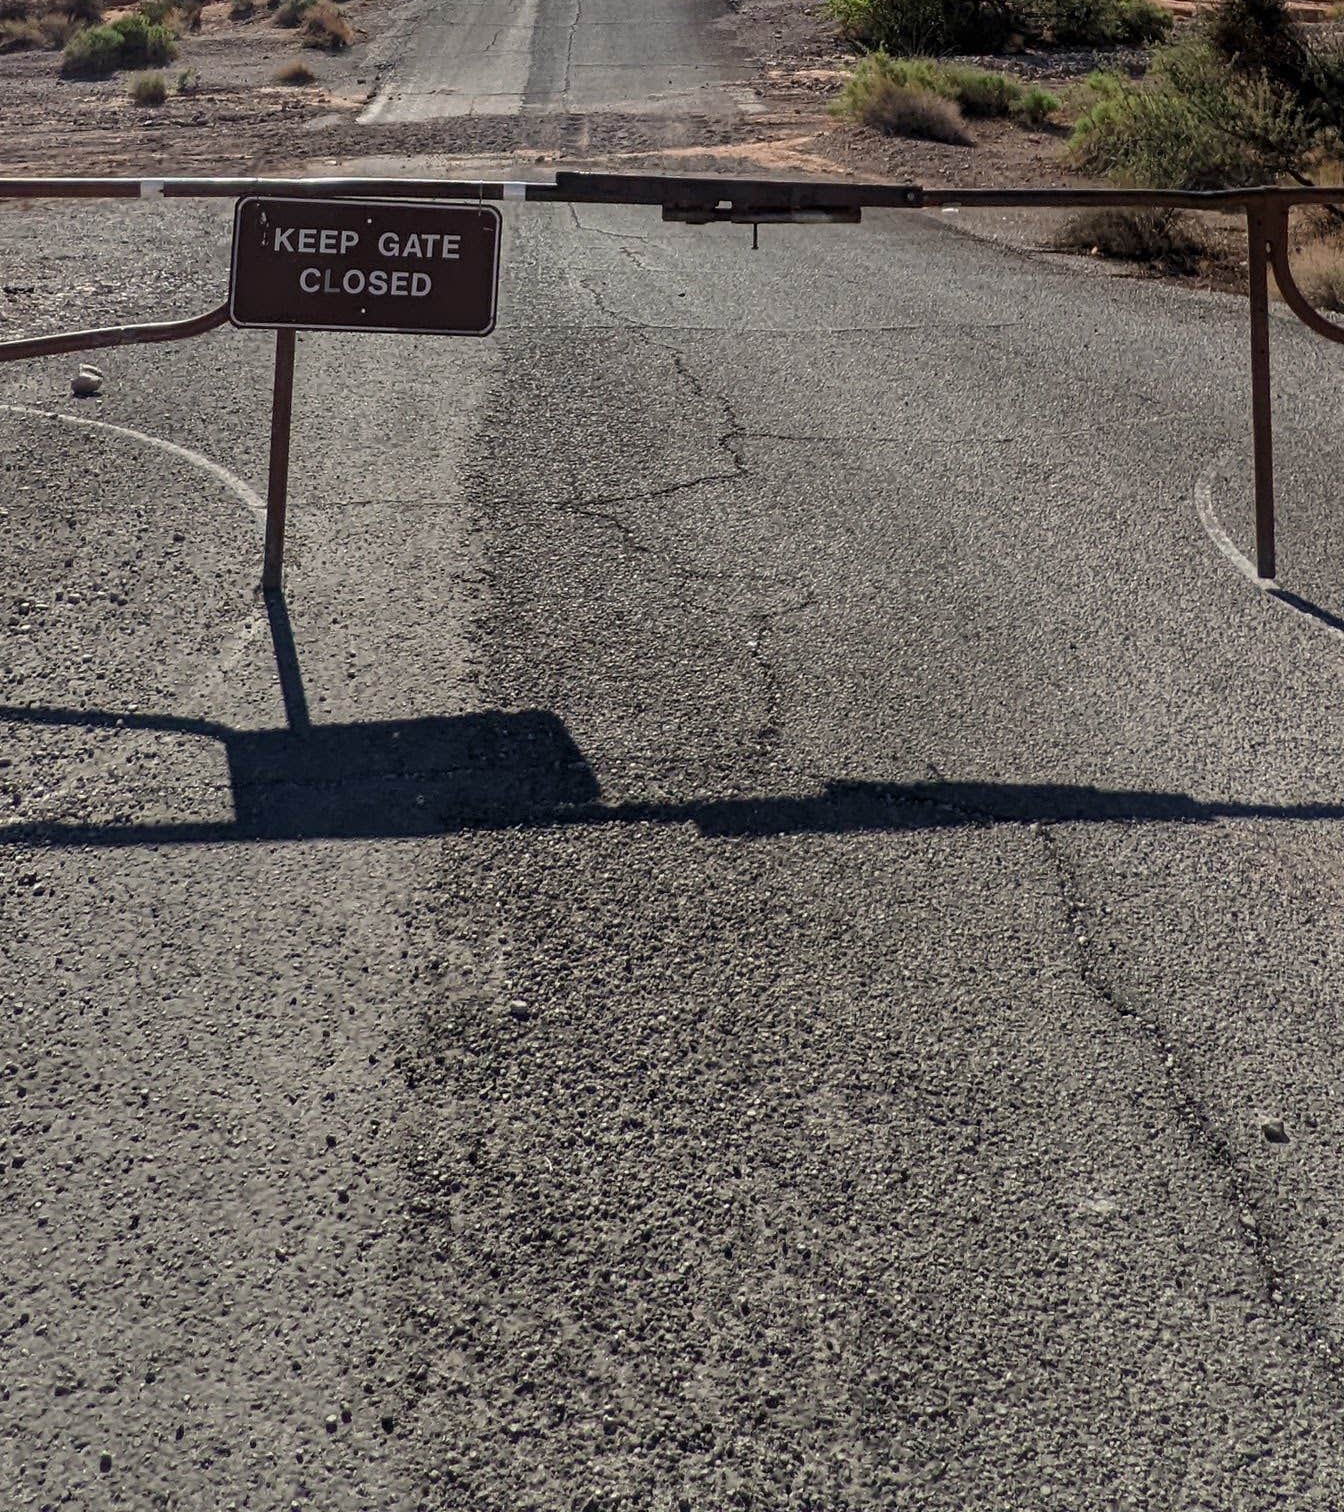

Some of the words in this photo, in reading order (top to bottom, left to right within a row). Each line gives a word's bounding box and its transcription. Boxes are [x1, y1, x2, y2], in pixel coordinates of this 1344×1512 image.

[273, 227, 359, 254] KEEP
[378, 231, 461, 259] GATE
[299, 268, 432, 297] CLOSED
